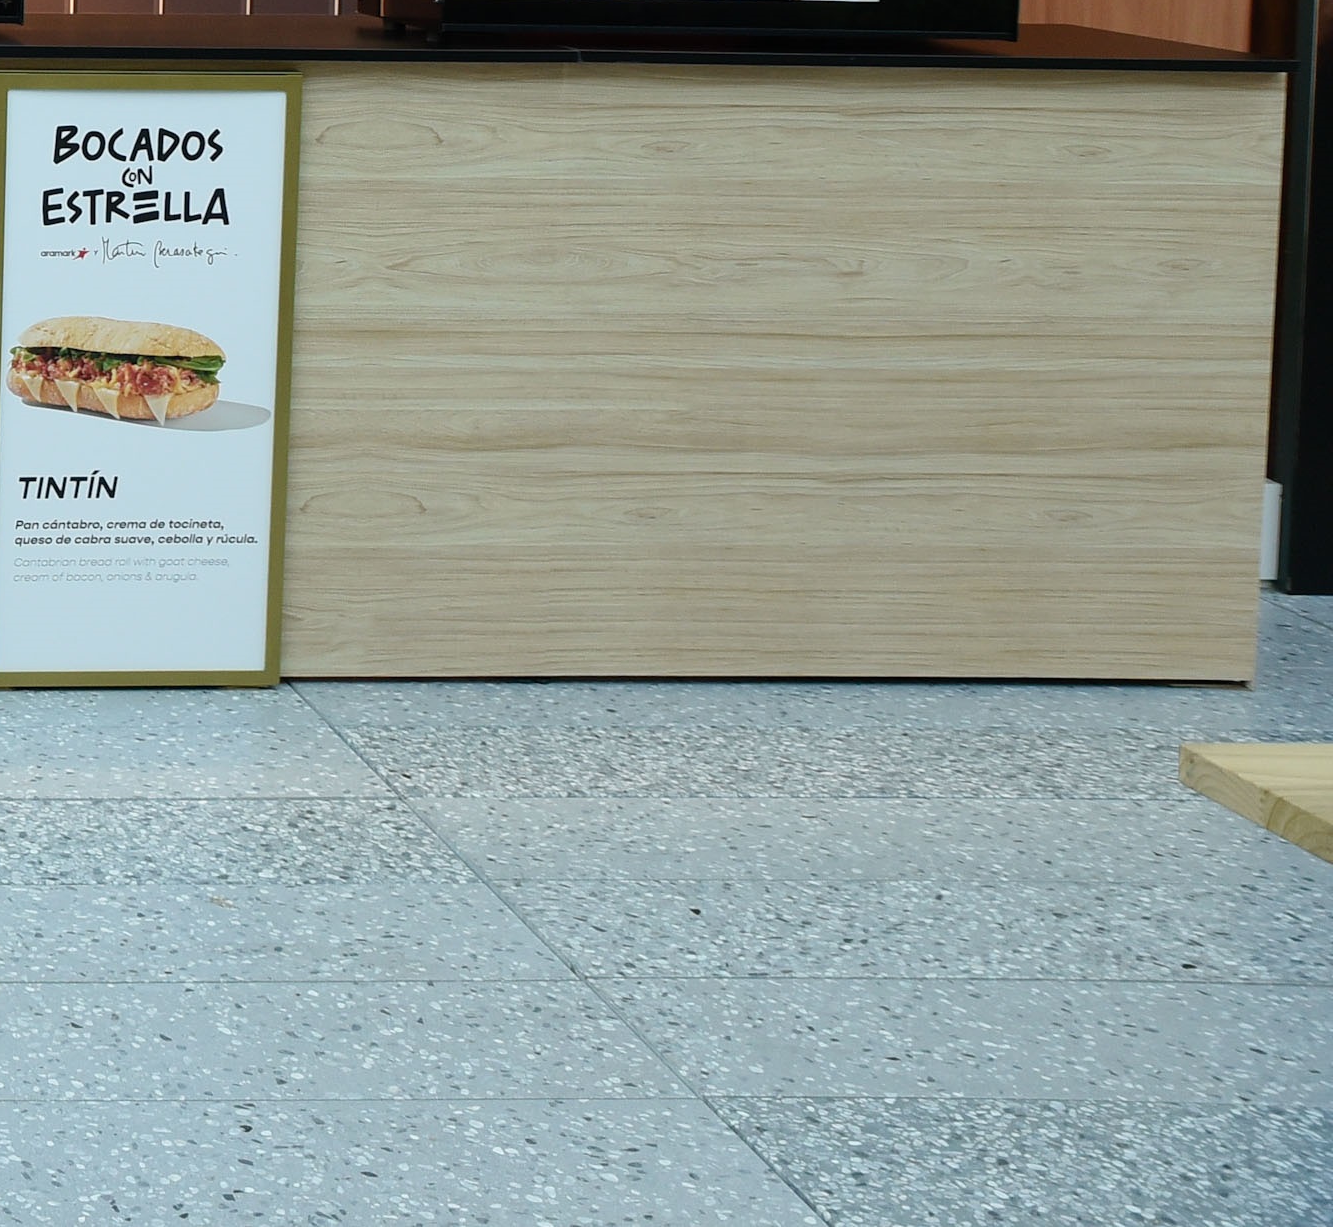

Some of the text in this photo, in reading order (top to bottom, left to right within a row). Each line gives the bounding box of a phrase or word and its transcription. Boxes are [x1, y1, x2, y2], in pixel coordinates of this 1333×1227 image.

[53, 125, 224, 165] BOCADOS
[42, 187, 230, 226] ESTRELLA
[40, 249, 76, 258] aramark
[18, 470, 119, 499] TINTÍN
[15, 519, 225, 532] Pan cántabro, crema de tocineta,
[14, 534, 258, 547] queso de cabra suave, cebolla y rúcula.
